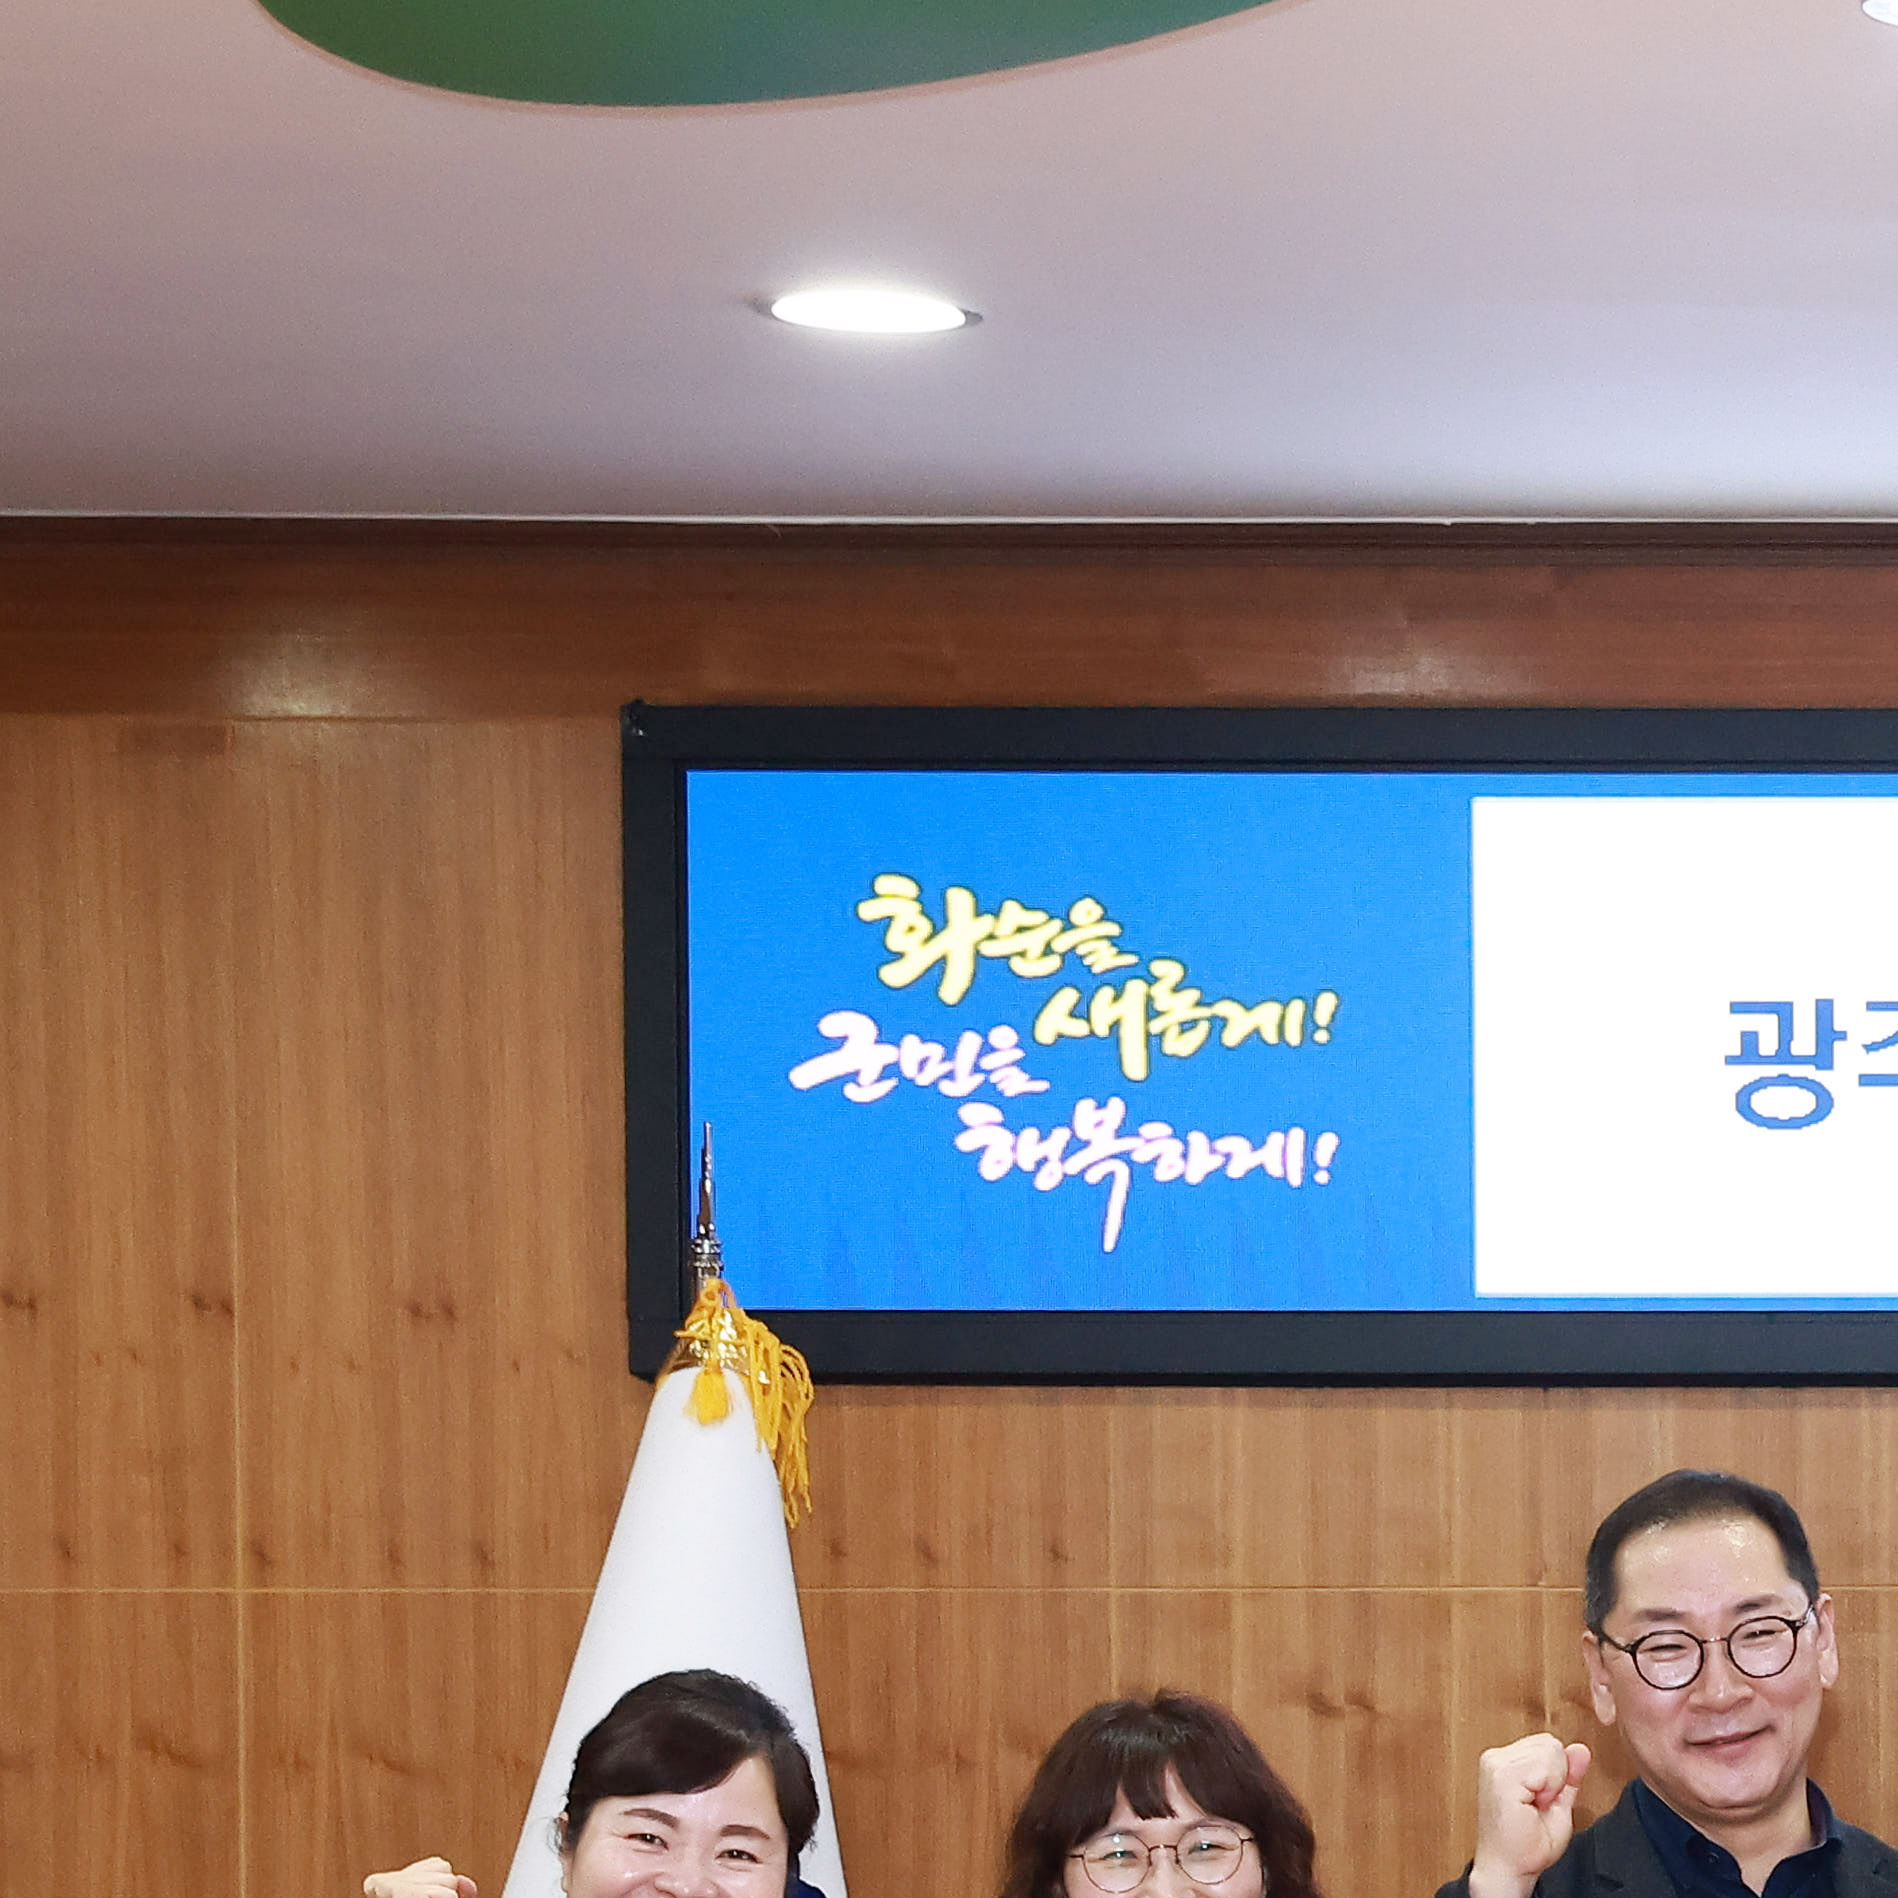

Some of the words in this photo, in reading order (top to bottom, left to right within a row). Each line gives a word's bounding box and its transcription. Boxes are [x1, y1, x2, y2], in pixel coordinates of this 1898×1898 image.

[857, 873, 1140, 1005] 화순을
[788, 1009, 1050, 1103] 군민을
[955, 1097, 1340, 1253] 행복하게!
